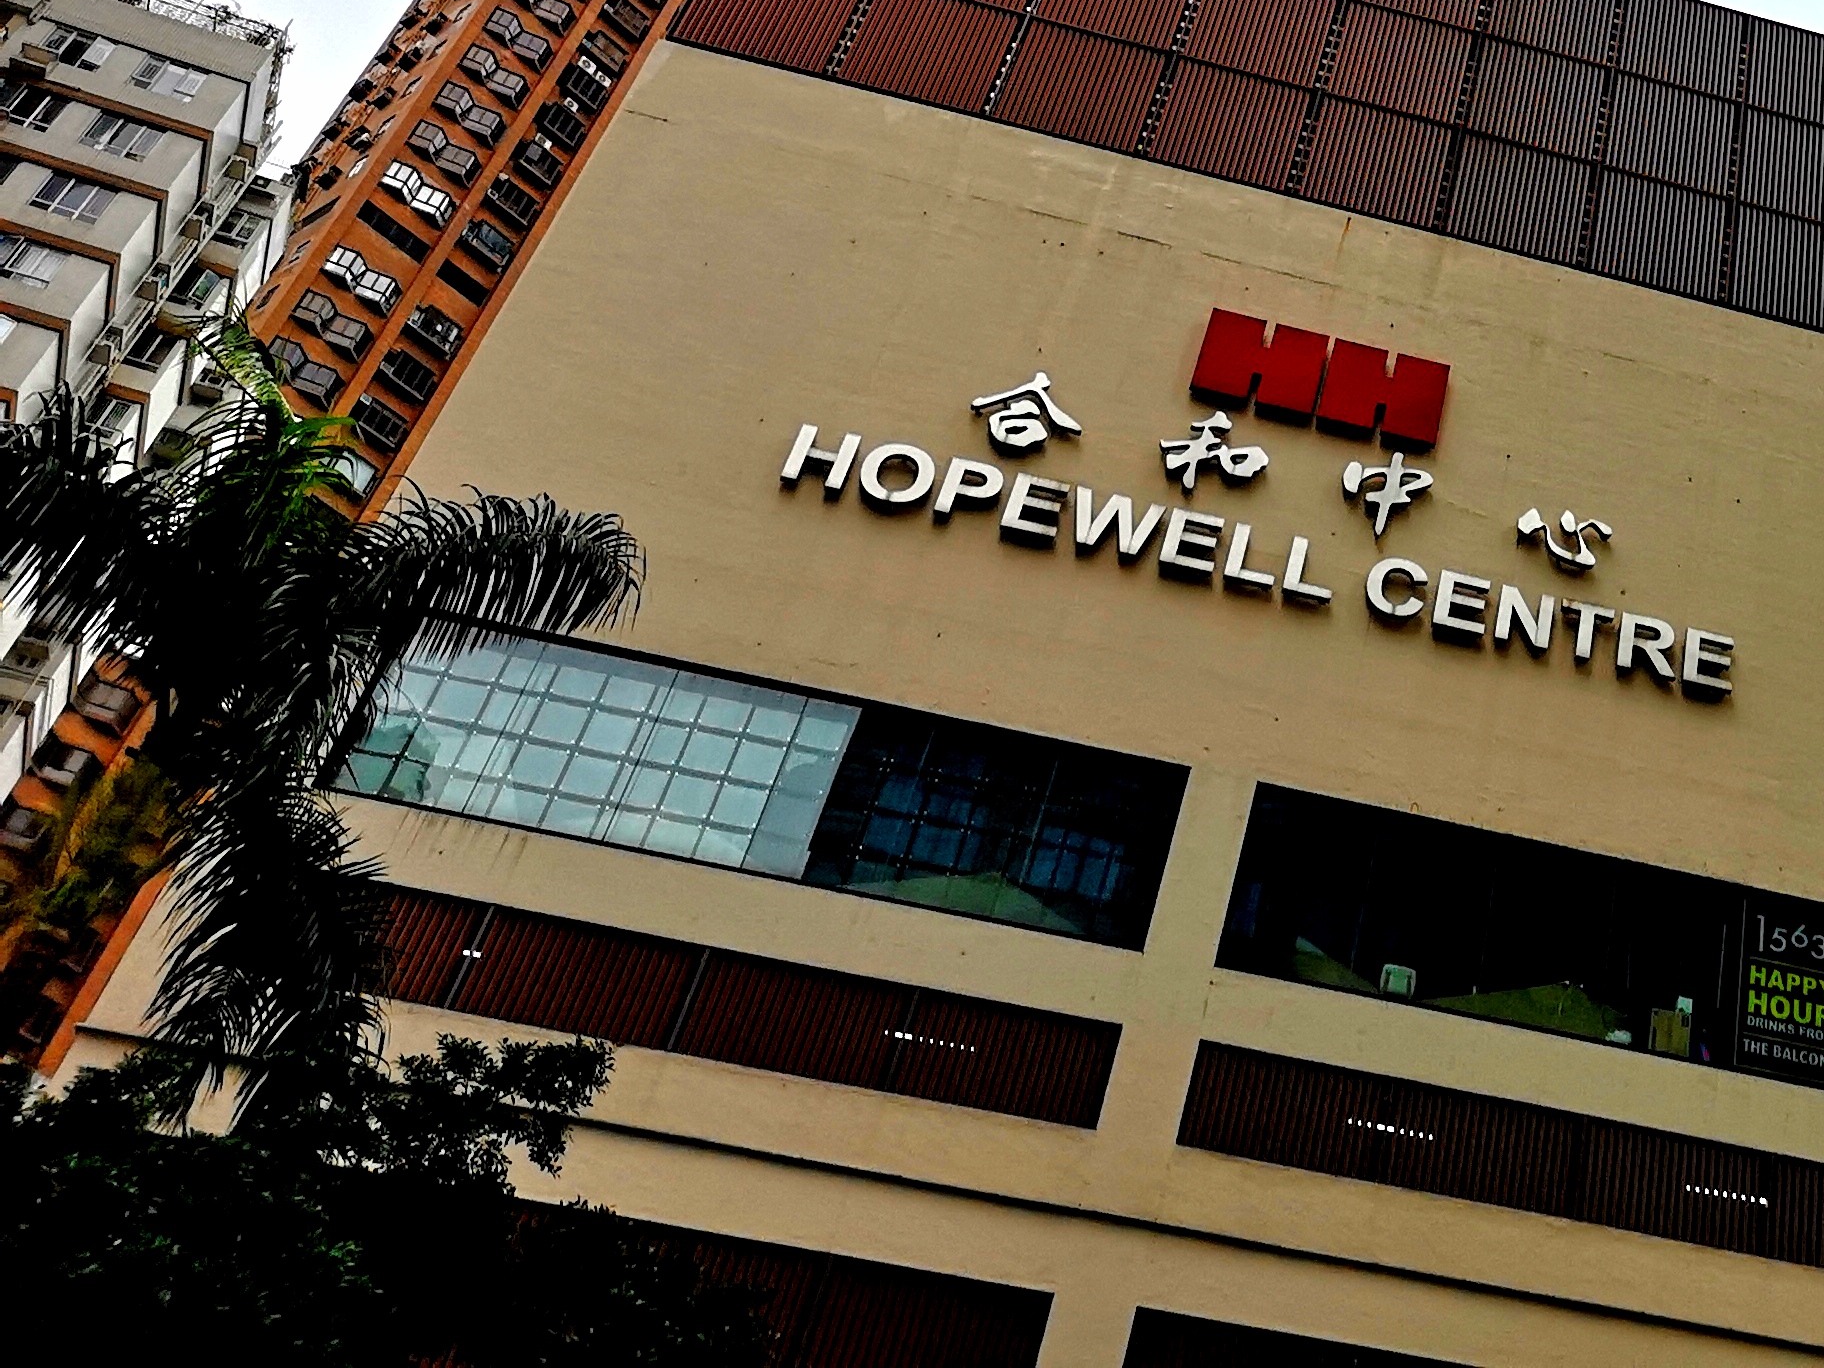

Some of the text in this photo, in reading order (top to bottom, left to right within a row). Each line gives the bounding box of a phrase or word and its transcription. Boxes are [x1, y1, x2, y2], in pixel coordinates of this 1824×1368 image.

[780, 423, 1735, 698] HOPEWELL CENTRE
[1746, 1014, 1795, 1034] DRINKS
[1742, 1038, 1769, 1056] THE
